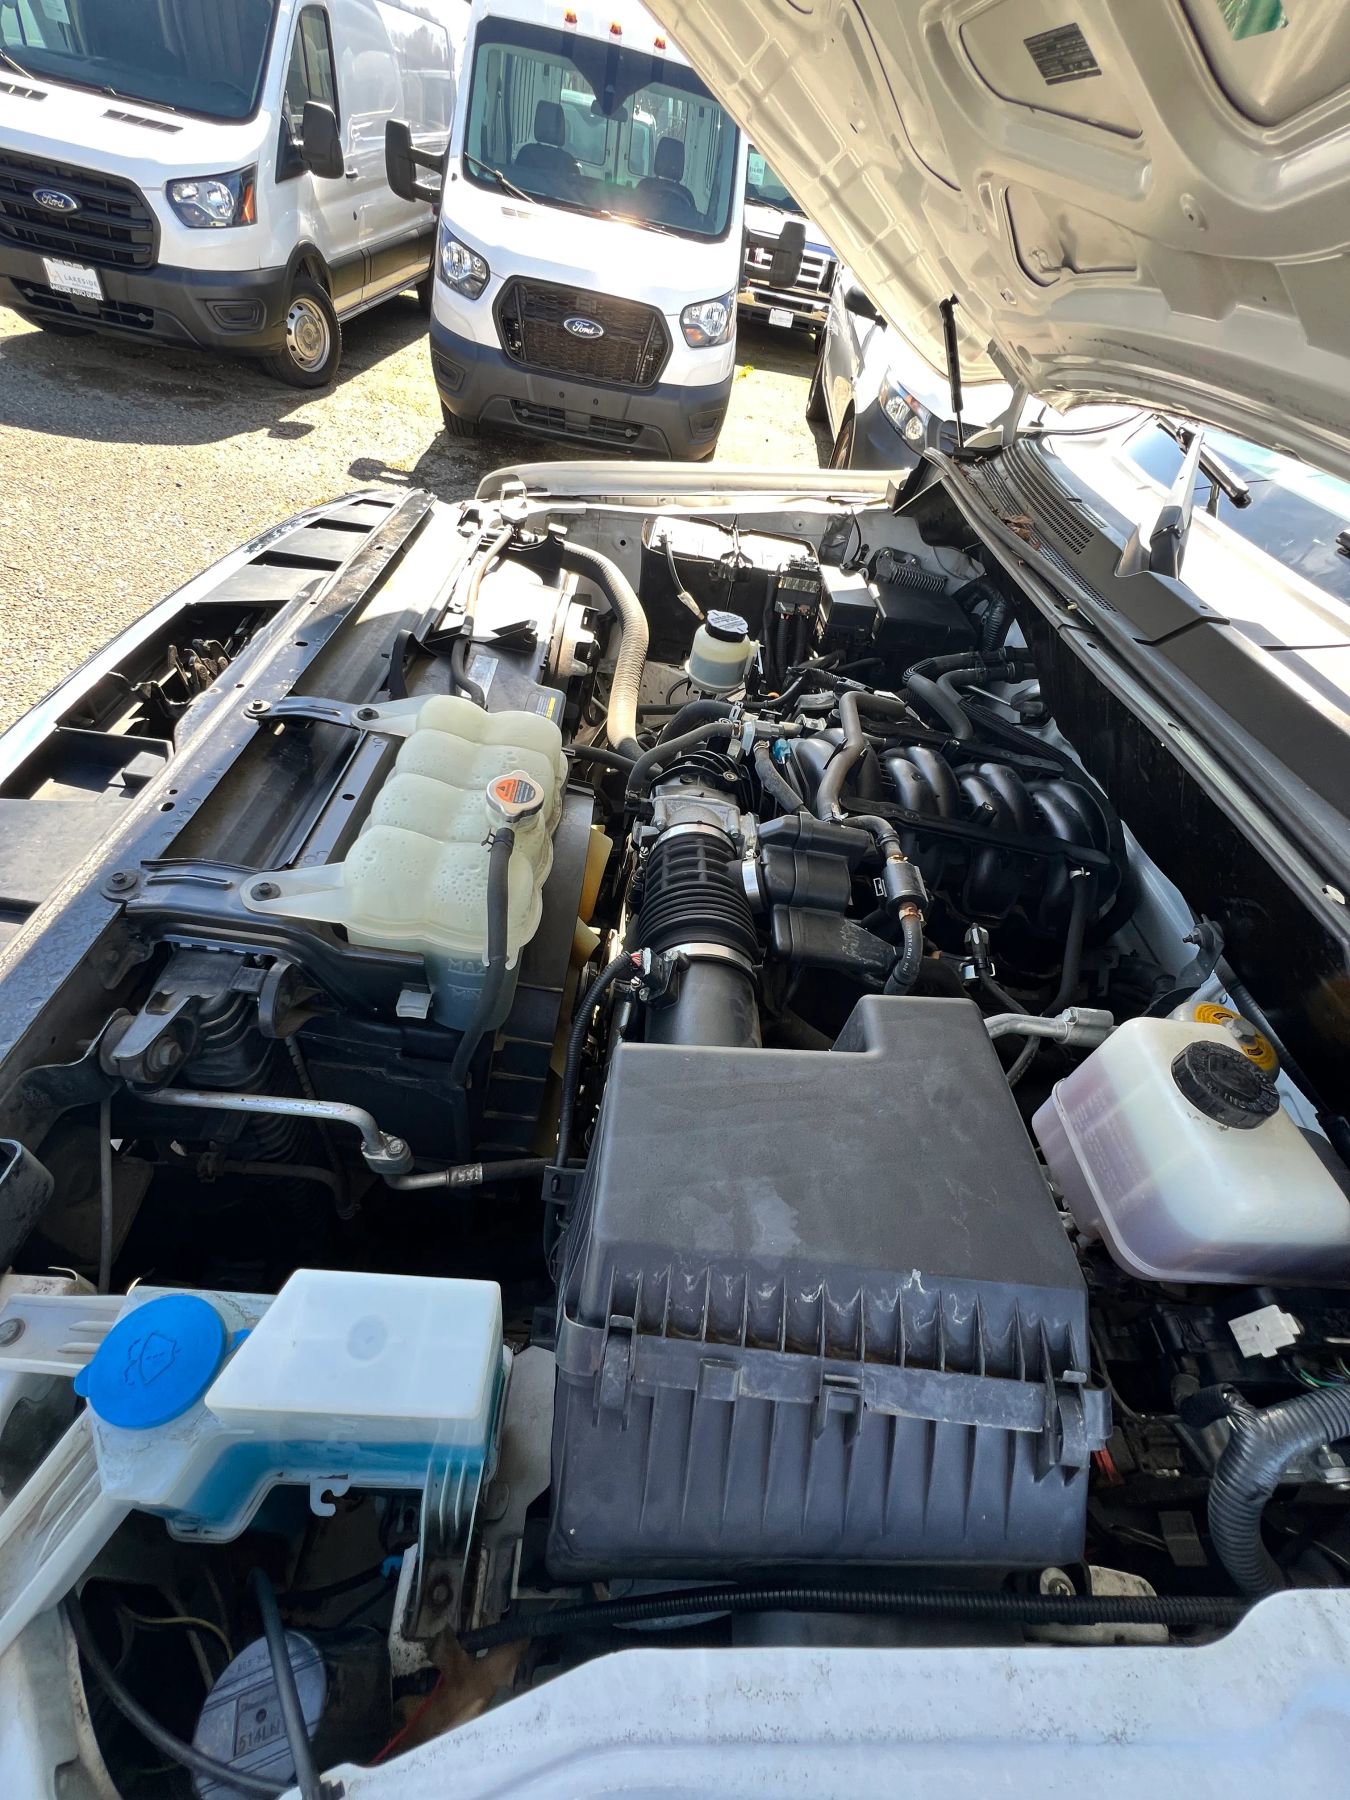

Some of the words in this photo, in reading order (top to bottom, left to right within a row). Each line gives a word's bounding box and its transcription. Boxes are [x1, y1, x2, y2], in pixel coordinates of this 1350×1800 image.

[40, 192, 65, 209] Ford
[64, 273, 97, 288] LAKESIDE
[573, 320, 598, 335] Ford
